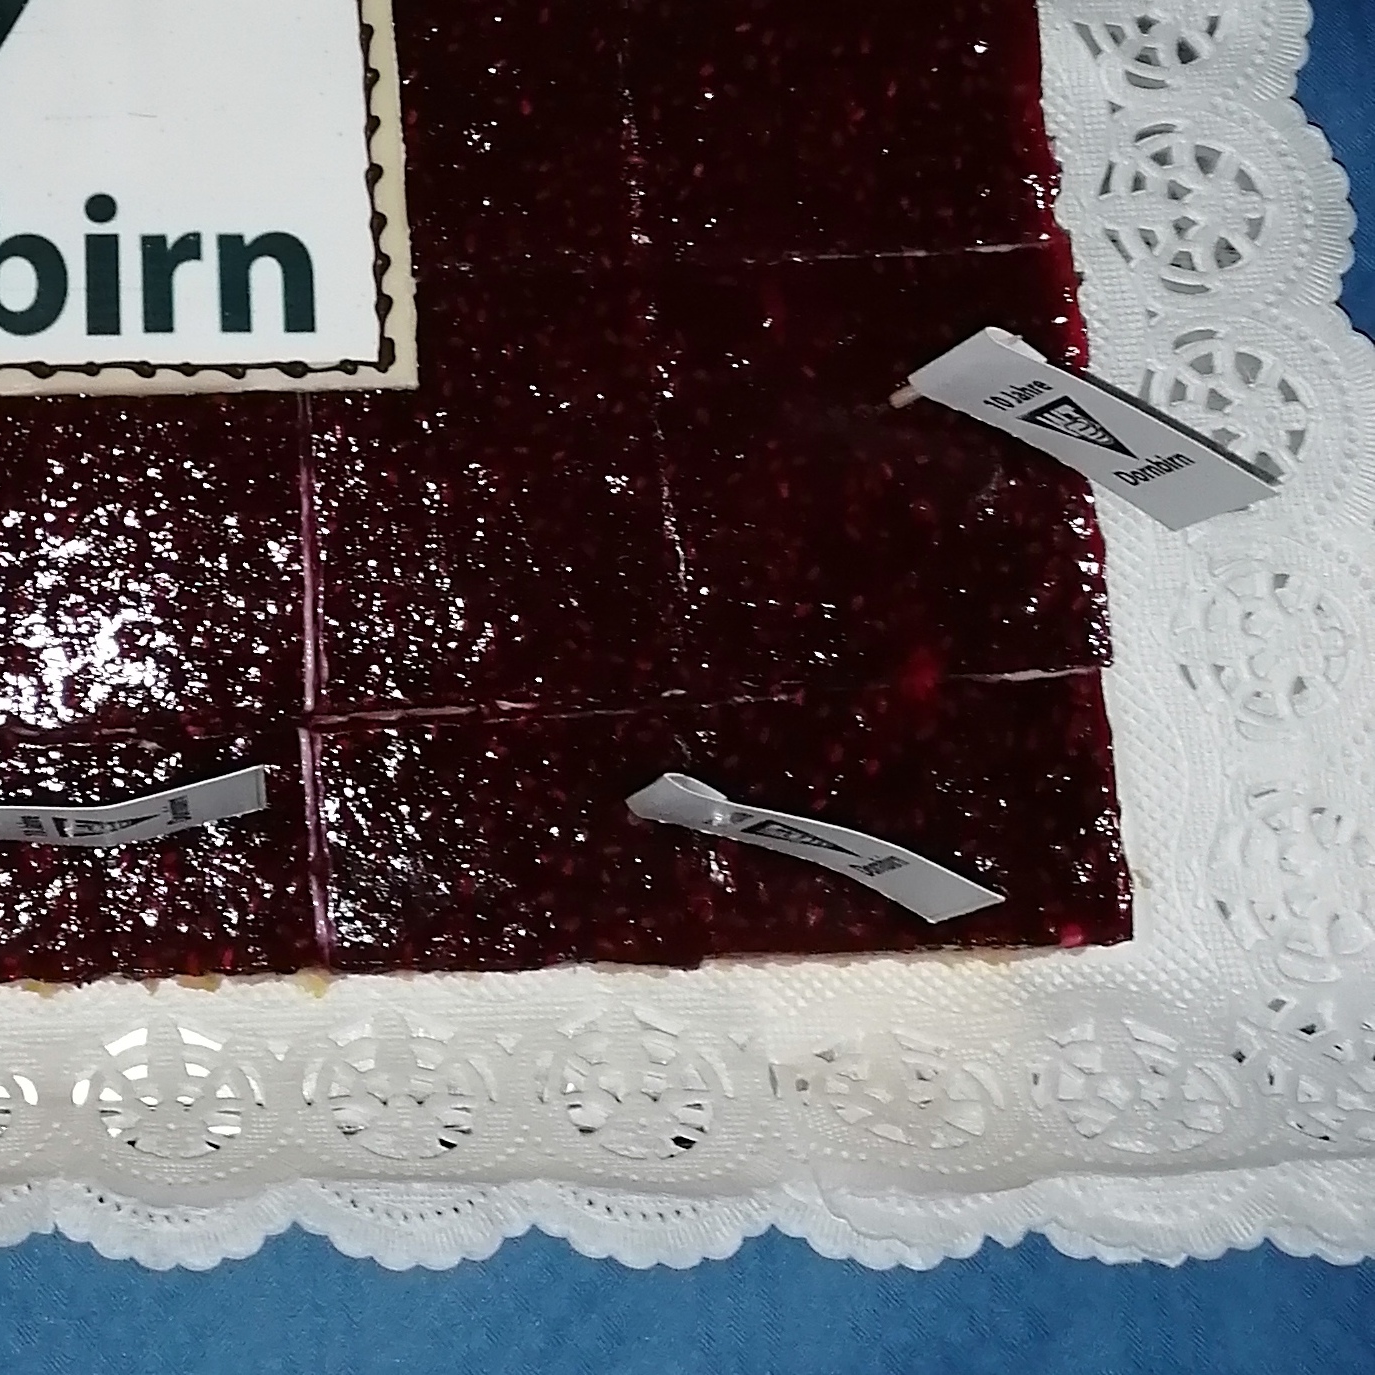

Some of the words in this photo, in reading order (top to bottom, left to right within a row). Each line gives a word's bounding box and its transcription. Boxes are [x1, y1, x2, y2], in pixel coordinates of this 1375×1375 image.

[983, 394, 1015, 412] 10
[1012, 379, 1053, 402] Jahre
[1113, 452, 1195, 486] Dornbirn
